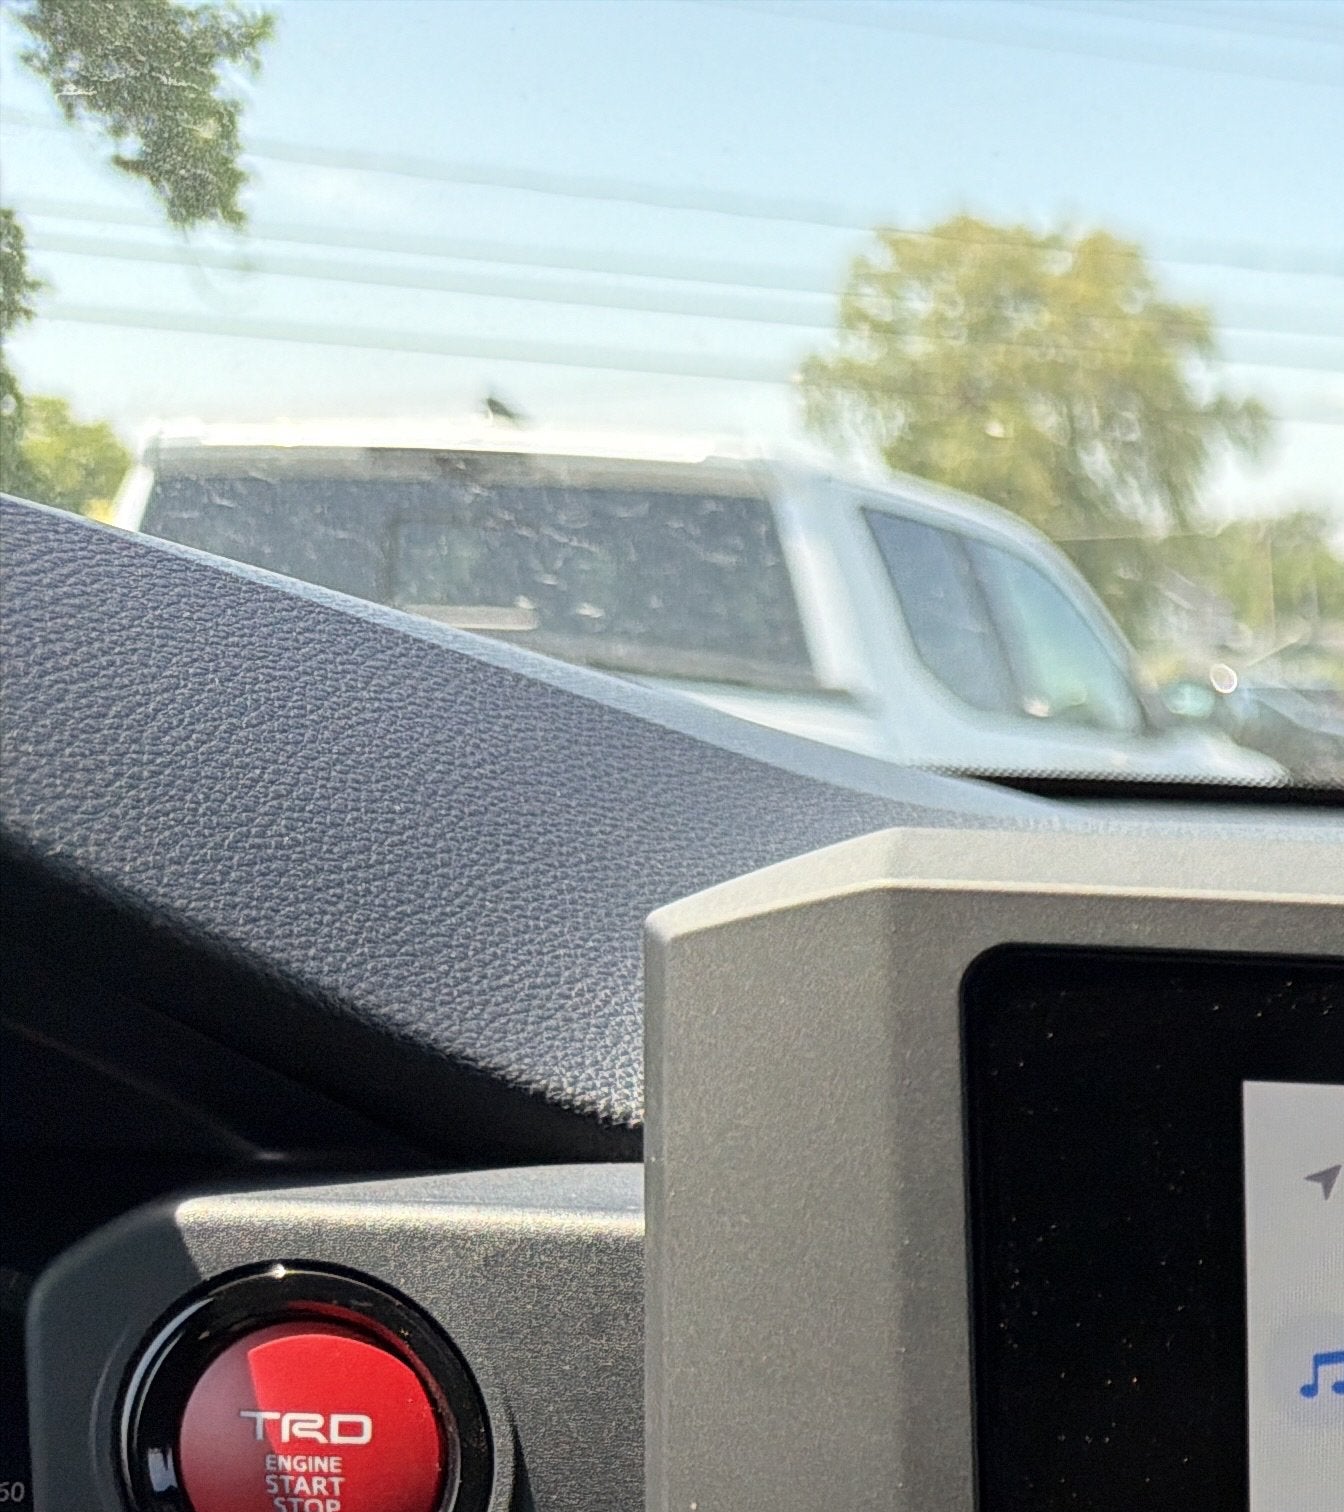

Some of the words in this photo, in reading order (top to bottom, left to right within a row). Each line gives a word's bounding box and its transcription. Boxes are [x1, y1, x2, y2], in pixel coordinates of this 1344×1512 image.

[239, 1410, 373, 1445] TRD
[265, 1454, 343, 1473] ENGINE
[265, 1474, 345, 1496] START
